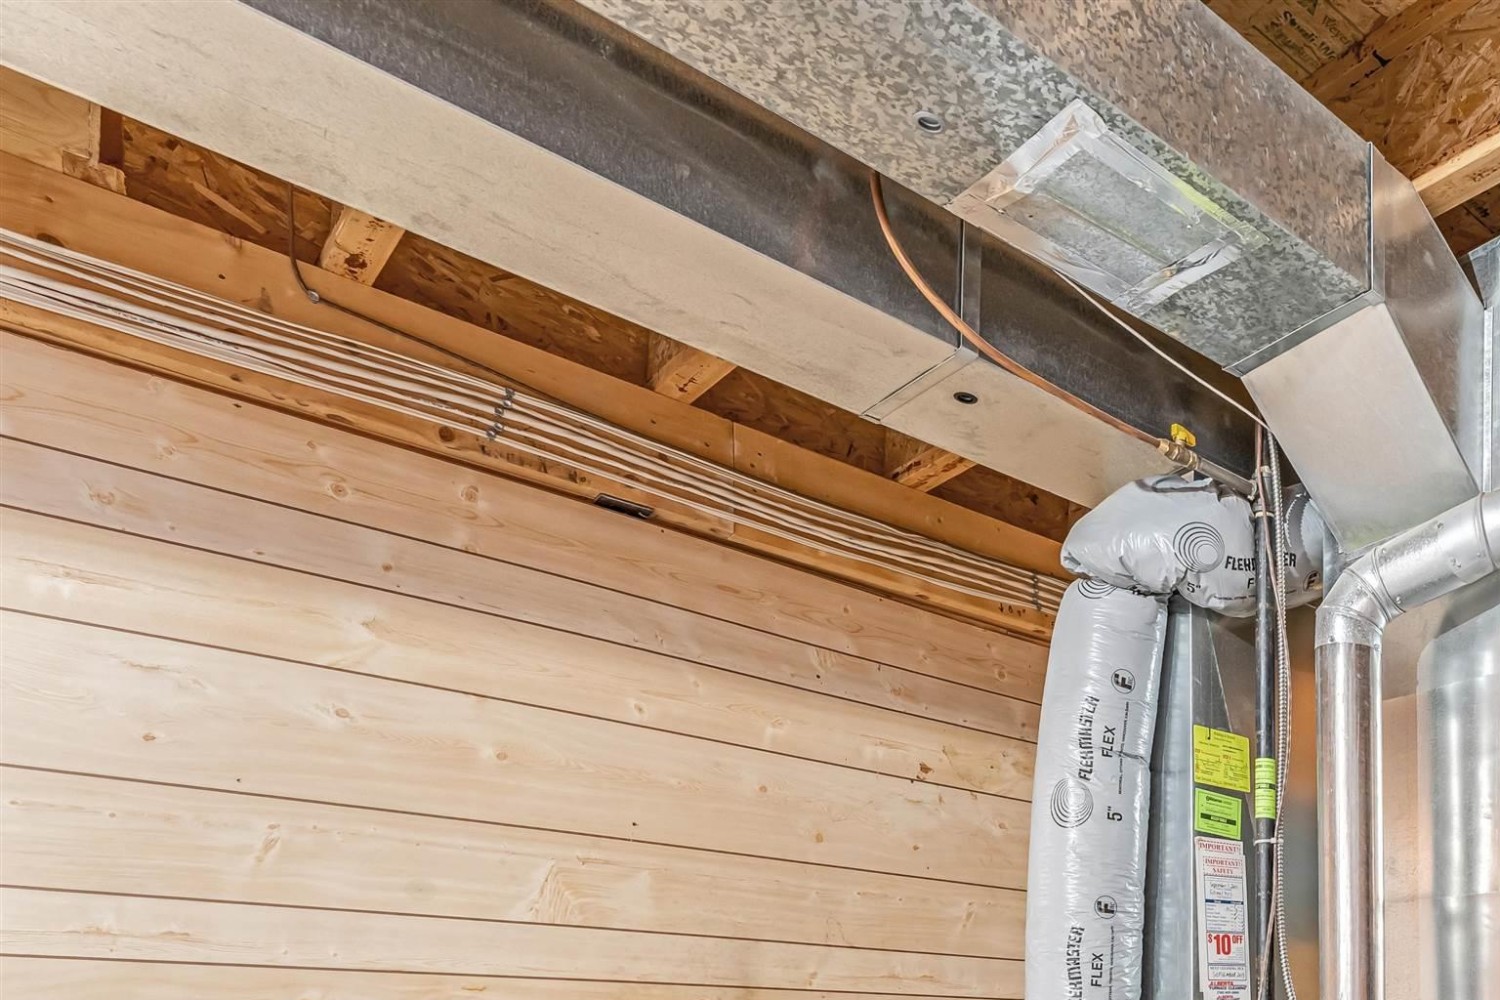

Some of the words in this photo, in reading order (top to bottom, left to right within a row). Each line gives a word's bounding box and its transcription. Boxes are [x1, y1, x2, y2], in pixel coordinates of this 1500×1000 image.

[1101, 725, 1116, 758] FLEX
[1107, 805, 1123, 822] 5"
[1231, 935, 1243, 944] OFF
[1091, 953, 1104, 988] FLEX
